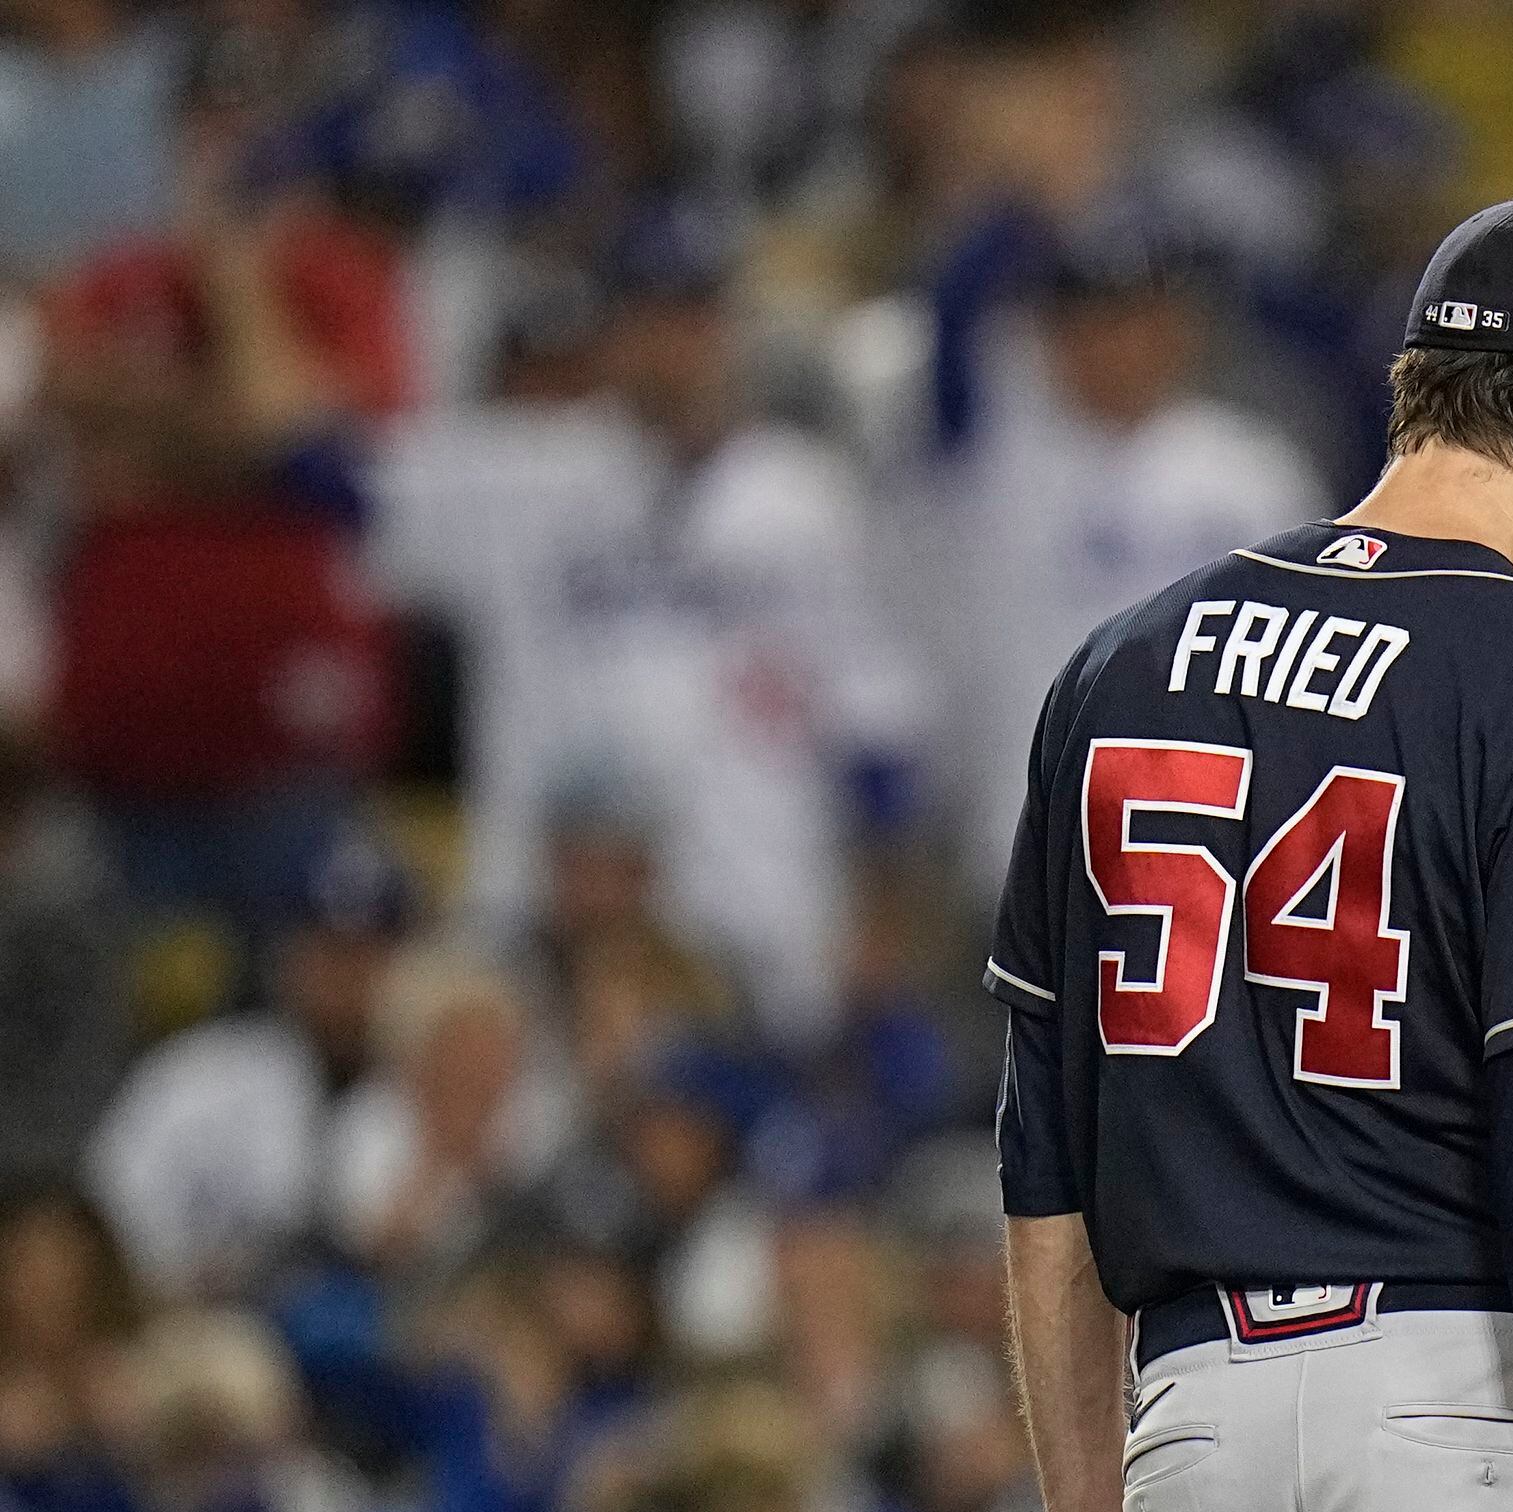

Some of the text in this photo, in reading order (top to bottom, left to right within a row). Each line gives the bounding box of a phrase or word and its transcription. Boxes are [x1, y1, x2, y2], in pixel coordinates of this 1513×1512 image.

[1425, 304, 1439, 322] 44
[1481, 310, 1504, 329] 35
[1168, 600, 1410, 720] FRIED
[1081, 738, 1411, 1090] 54
